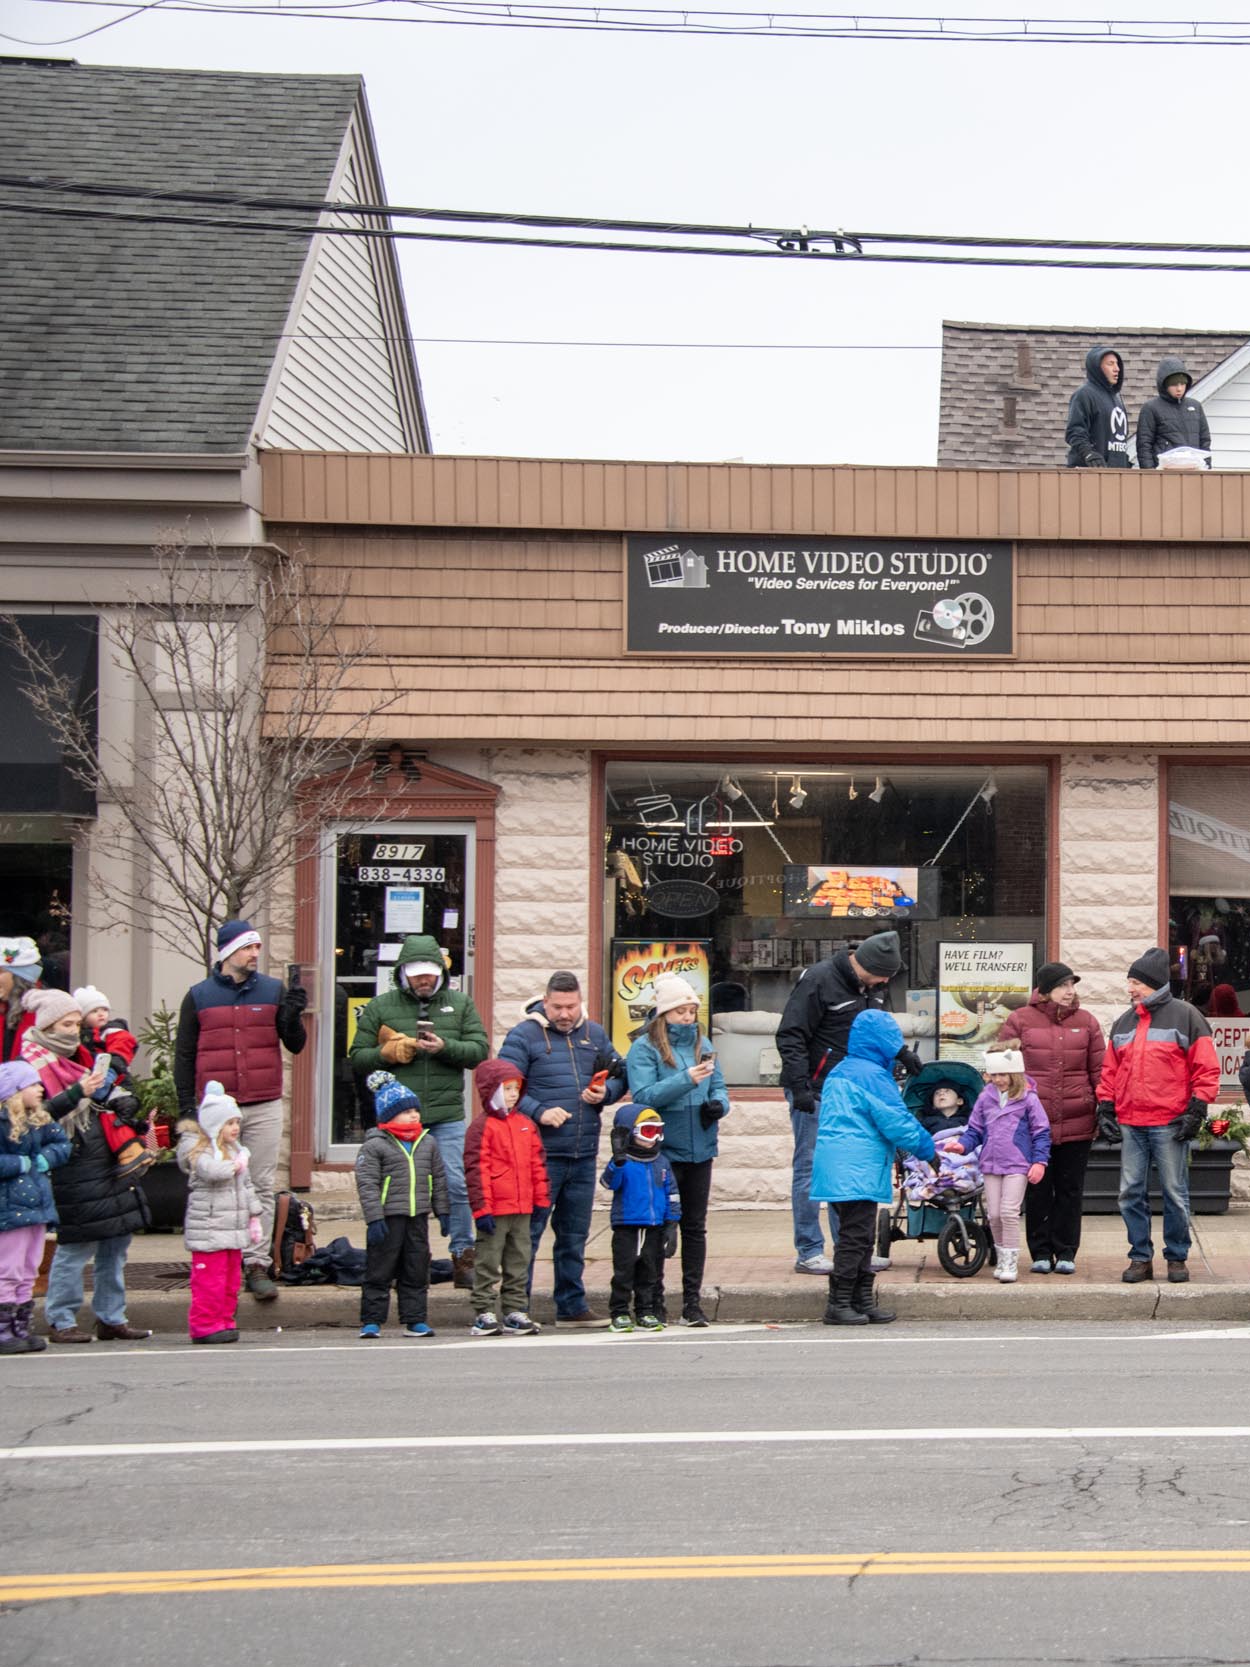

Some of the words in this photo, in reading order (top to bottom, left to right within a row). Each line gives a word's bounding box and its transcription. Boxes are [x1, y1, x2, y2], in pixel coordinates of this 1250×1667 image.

[716, 549, 797, 574] HOME
[803, 551, 885, 575] VIDEO
[747, 577, 793, 590] "Video
[795, 577, 855, 591] Services
[858, 578, 878, 591] for
[658, 622, 779, 636] Producer/Director
[781, 619, 831, 638] Tony
[837, 619, 905, 636] Miklos
[376, 845, 423, 858] 8917
[622, 837, 679, 851] HOME
[683, 839, 743, 853] VIDEO
[642, 852, 714, 868] STUDIO
[360, 867, 444, 881] 838-4336
[944, 951, 970, 959] HAVE
[973, 951, 1003, 959] FILM?
[945, 962, 972, 971] WE'LL
[975, 963, 1027, 972] TRANSFER!
